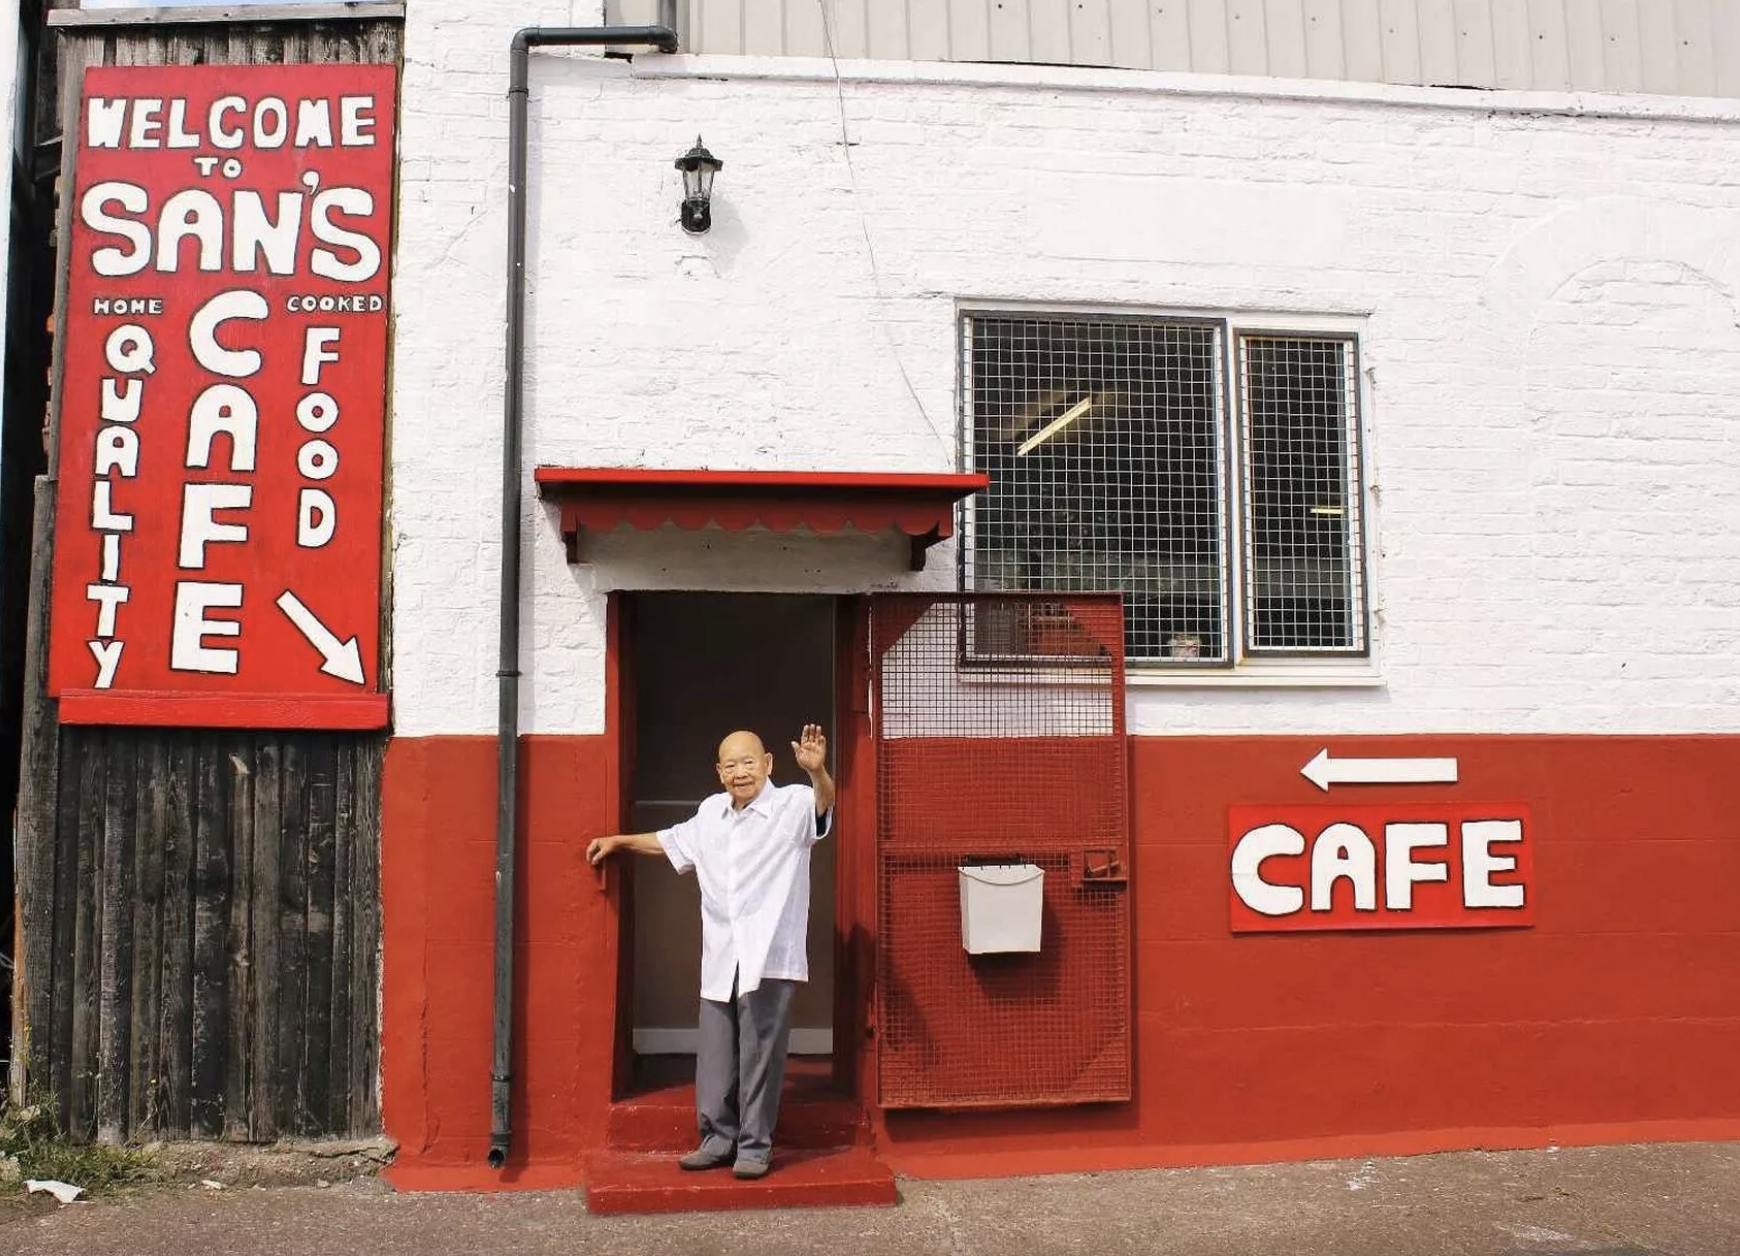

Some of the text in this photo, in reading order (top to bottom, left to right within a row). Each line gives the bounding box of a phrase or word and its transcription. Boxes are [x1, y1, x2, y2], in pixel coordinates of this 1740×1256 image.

[87, 96, 376, 149] WELCOME
[193, 157, 243, 179] TO
[81, 170, 382, 283] SAN'S
[94, 295, 383, 316] HOME COOKED
[171, 290, 270, 675] CAFE
[296, 327, 341, 547] FOOD
[87, 324, 156, 691] QUALITY
[1231, 820, 1525, 916] CAFE
